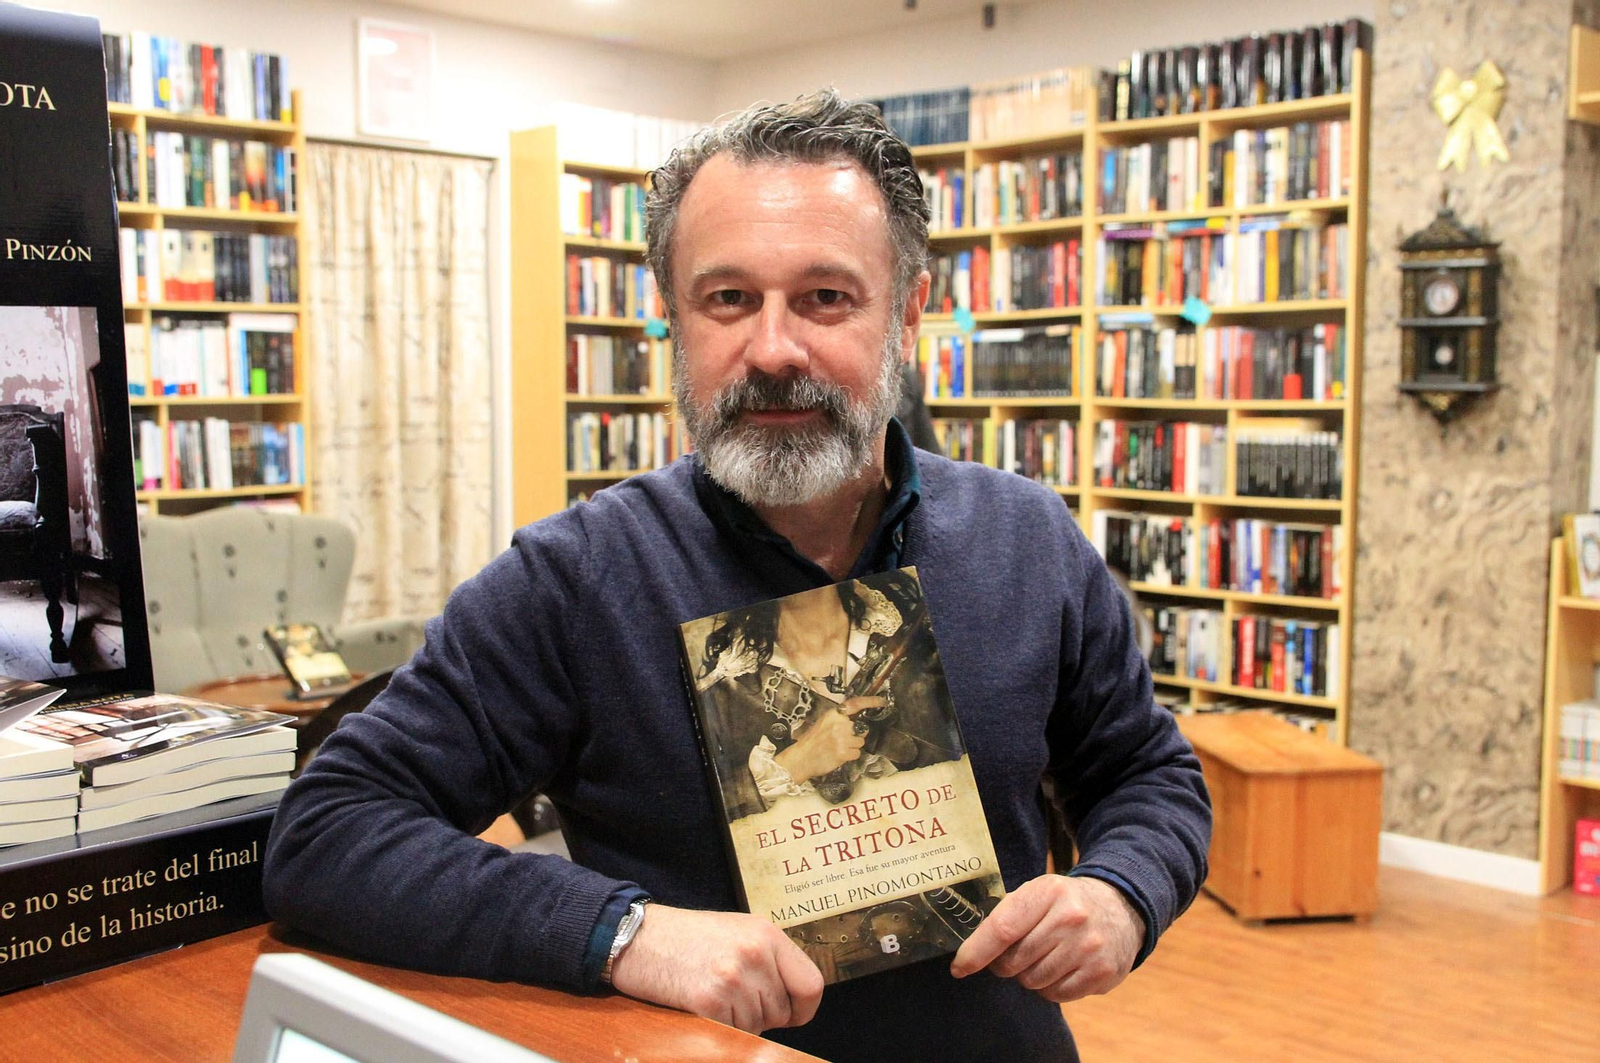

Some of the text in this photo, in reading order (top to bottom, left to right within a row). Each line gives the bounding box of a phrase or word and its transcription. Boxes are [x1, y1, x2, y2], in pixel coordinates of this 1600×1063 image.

[755, 784, 957, 849] EL SECRETO DE
[782, 816, 948, 877] LA TRITONA
[25, 892, 59, 915] no
[67, 884, 94, 905] se
[101, 868, 157, 897] trate
[164, 853, 200, 882] del
[208, 840, 259, 873] final
[770, 856, 982, 924] MANUEL PINOMONTANO
[784, 843, 957, 894] Eligió ser libre. Esa fue su mayor aventura
[0, 891, 225, 964] sino de la historia.
[880, 933, 901, 954] B
